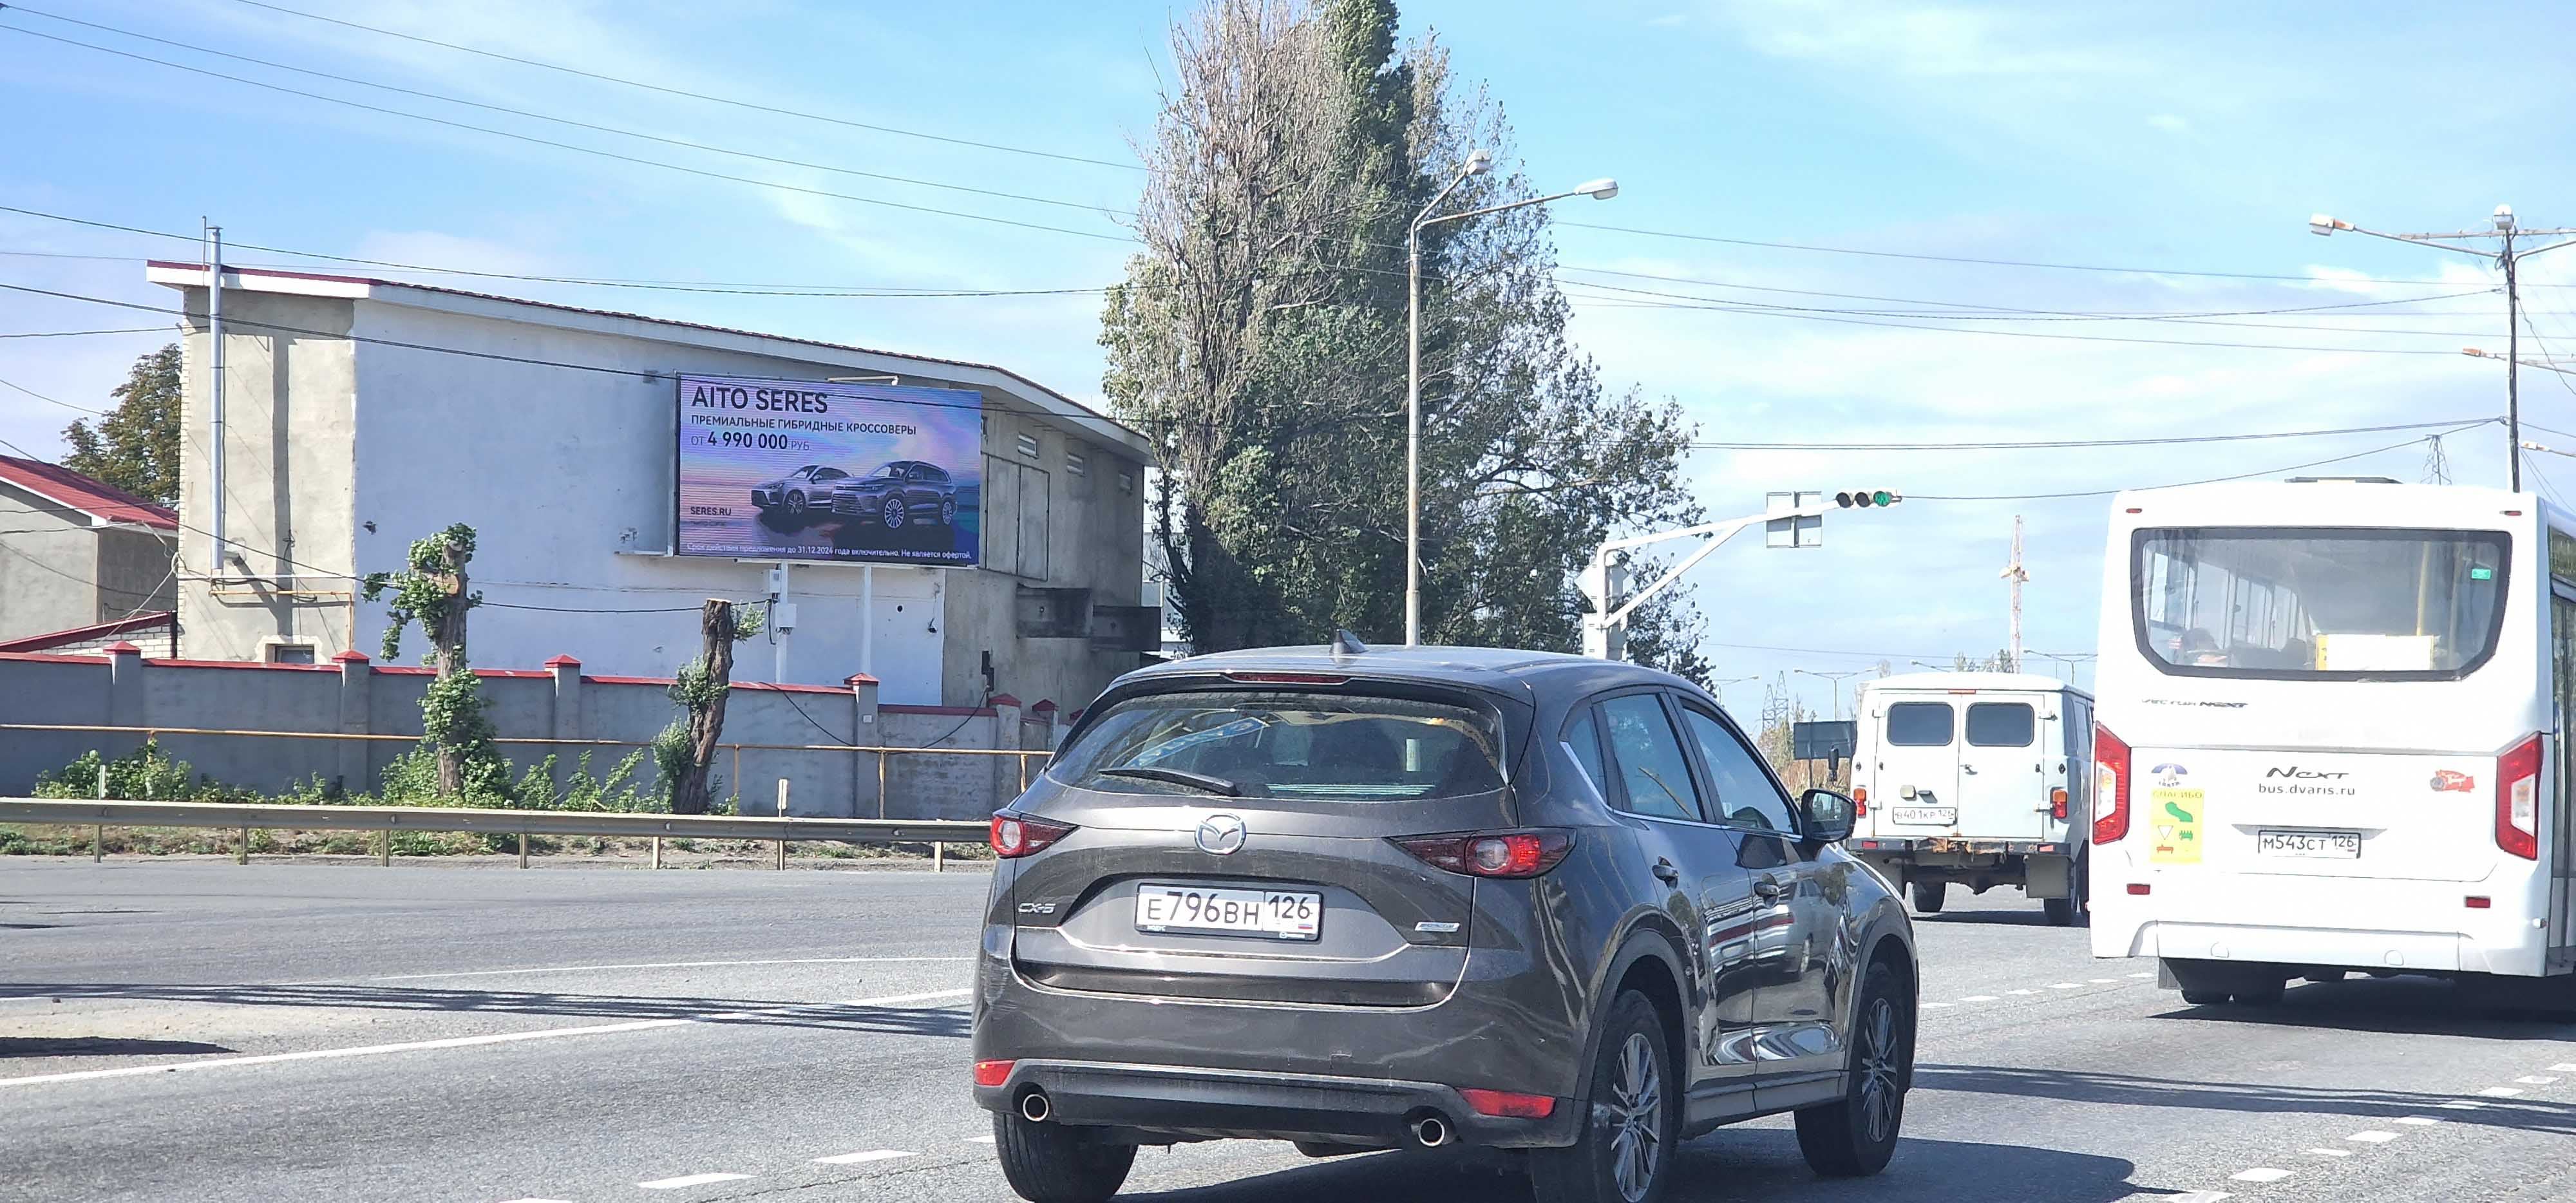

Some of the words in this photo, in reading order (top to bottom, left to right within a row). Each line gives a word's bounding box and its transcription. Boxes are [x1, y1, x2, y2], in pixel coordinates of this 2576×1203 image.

[692, 386, 748, 409] AITO
[755, 389, 828, 413] SERES
[691, 415, 775, 428] ПРЕМИАЛЬНЫЕ
[778, 419, 844, 432] ГИБРИДНЫЕ
[846, 422, 916, 435] КРОССОВЕРЫ
[691, 435, 705, 446] ОТ
[707, 431, 717, 446] 4
[723, 431, 753, 448] 990
[758, 433, 788, 450] 000
[690, 506, 732, 516] SERES.RU
[798, 546, 833, 554] 31.12.2024
[902, 549, 911, 557] Не
[2259, 783, 2355, 796] bus.dvaris.ru
[2331, 835, 2354, 848] 126
[1018, 903, 1056, 914] CX-5
[1268, 895, 1310, 920] 126
